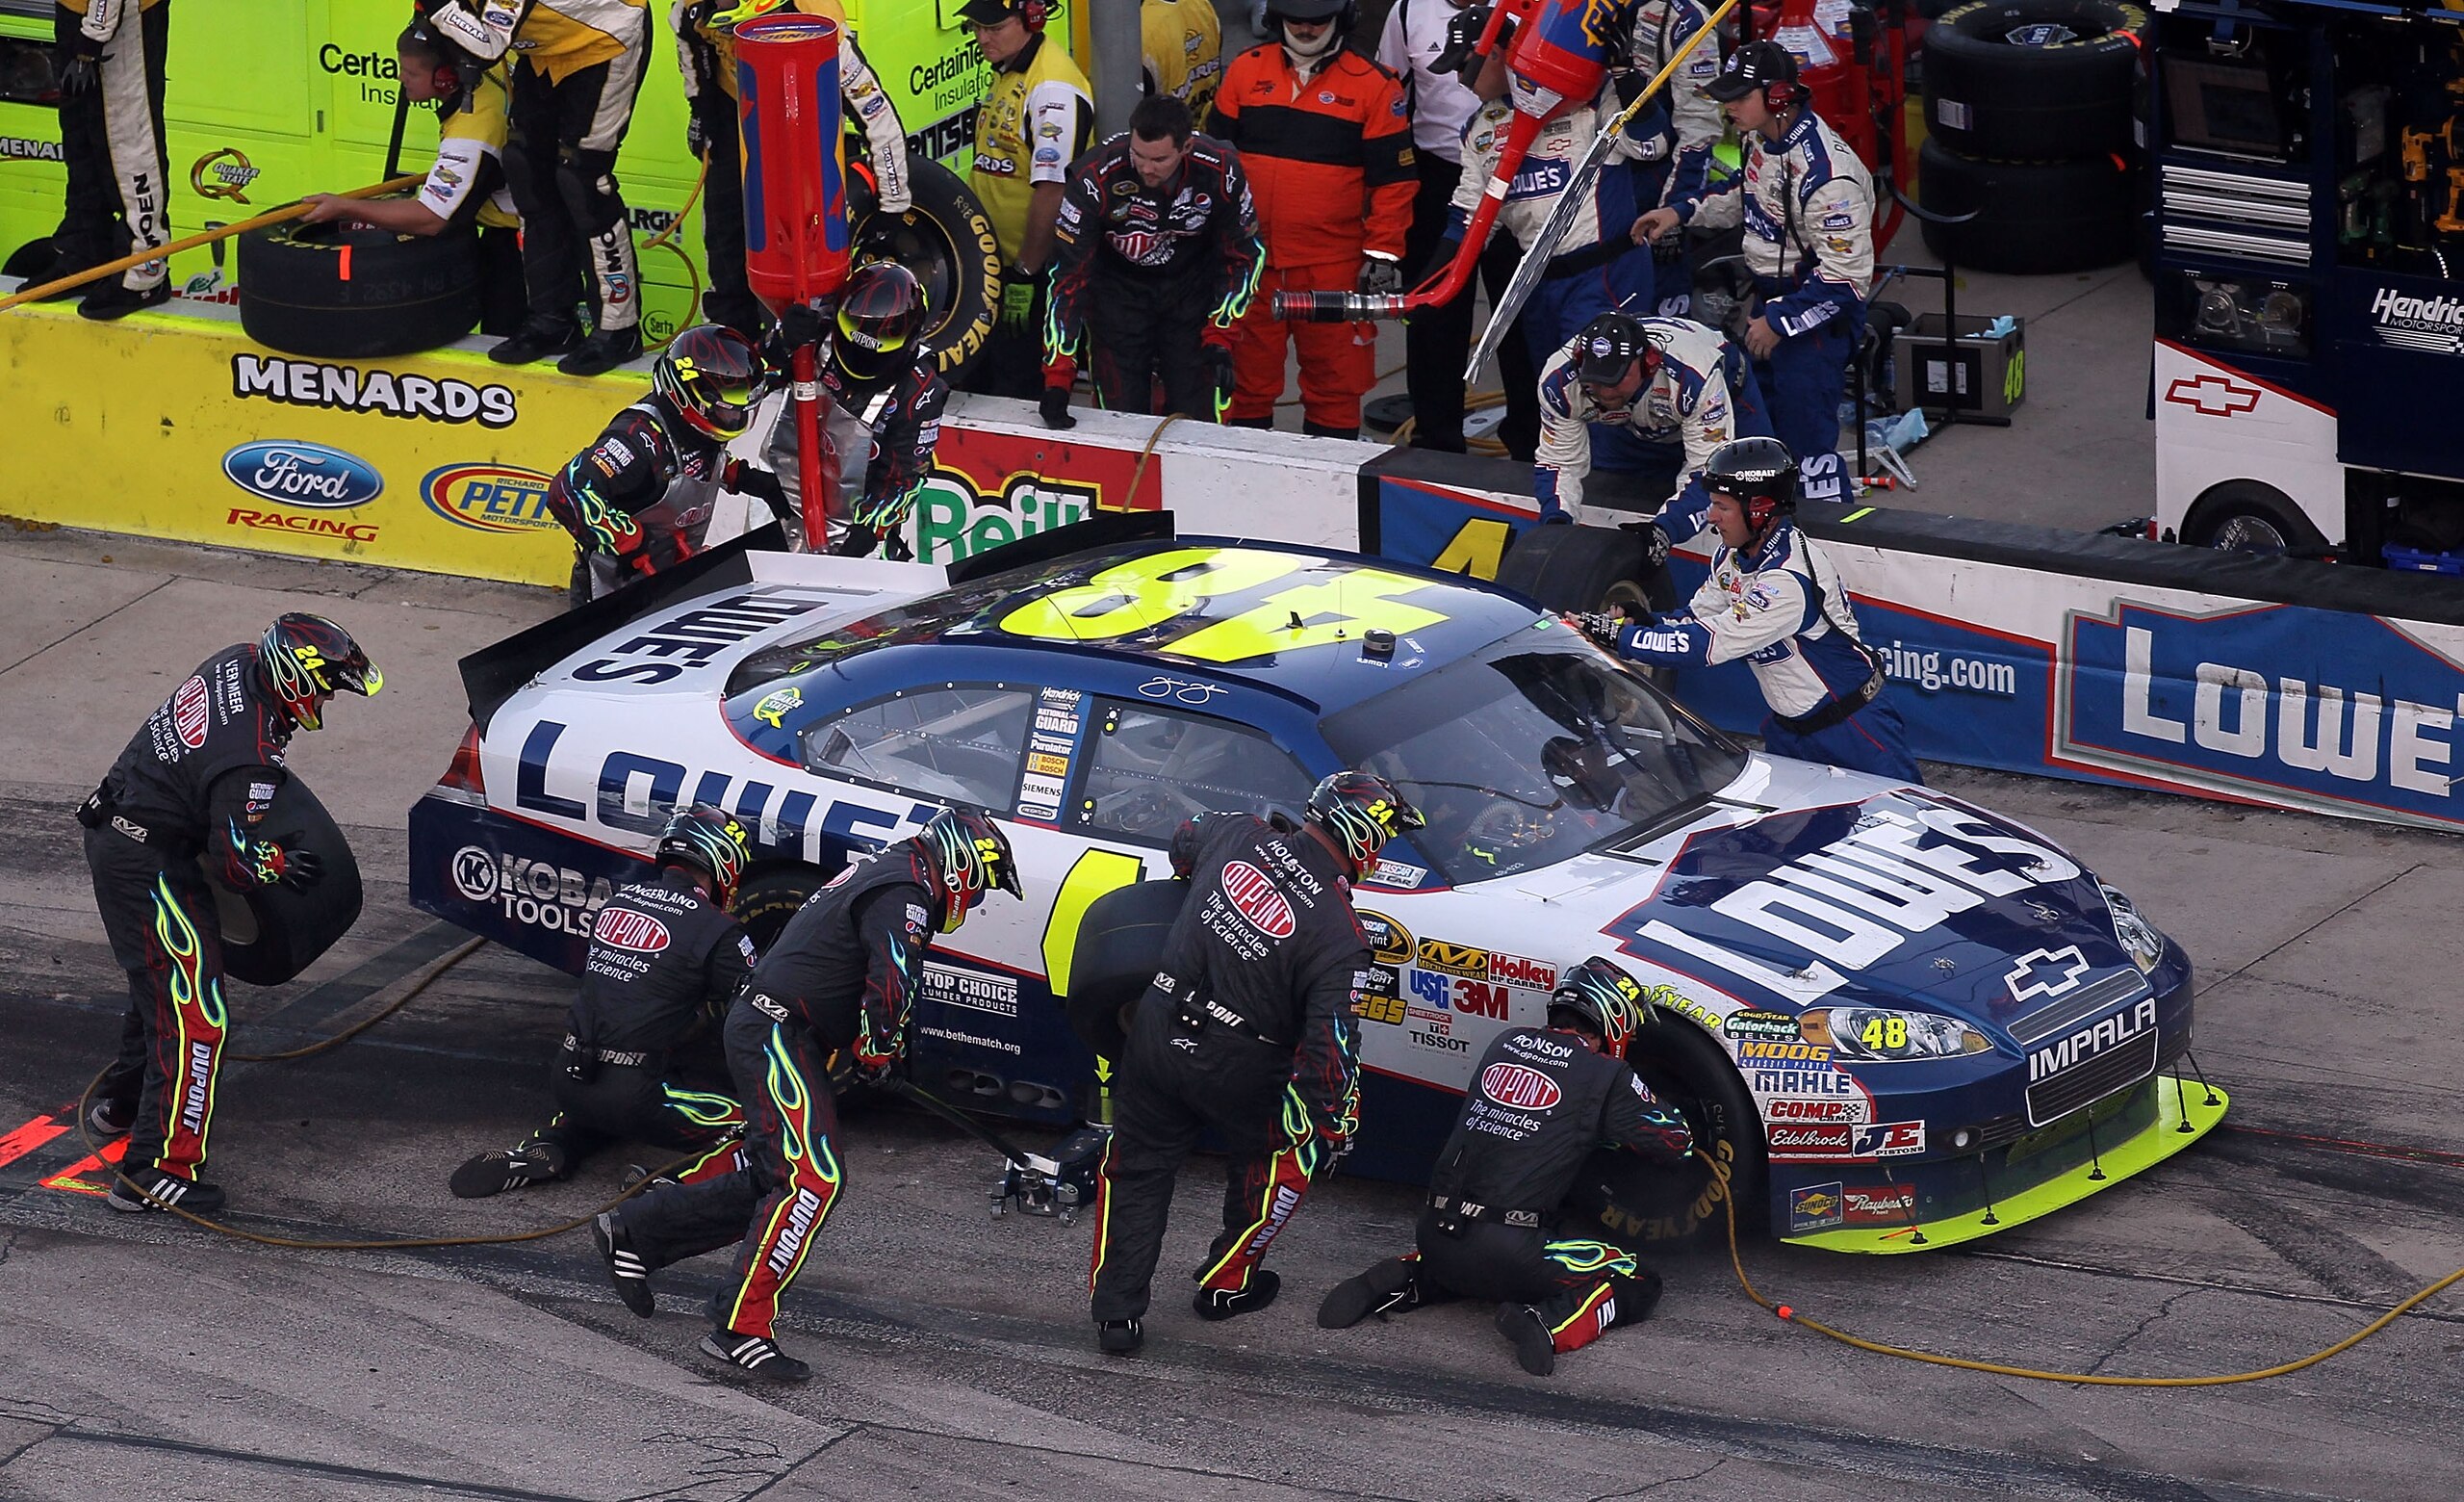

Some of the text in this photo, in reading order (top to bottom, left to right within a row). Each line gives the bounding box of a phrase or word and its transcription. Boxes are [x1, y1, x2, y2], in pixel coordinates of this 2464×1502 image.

[320, 43, 397, 79] Certa
[910, 41, 984, 96] CertainTe
[935, 68, 993, 111] Insulatio
[213, 163, 260, 177] QUAKER
[975, 155, 1015, 171] ARDS
[220, 174, 250, 186] STATE
[2371, 288, 2464, 325] Hendric
[650, 317, 673, 334] Serta
[2390, 317, 2464, 335] MOTORSPOR
[674, 356, 700, 382] 24
[2003, 350, 2024, 399] 48
[234, 355, 517, 428] MENARDS
[254, 450, 348, 500] Ford
[496, 478, 545, 489] RICHARD
[1745, 469, 1776, 478] KOBALT
[459, 480, 552, 516] PETT
[226, 508, 379, 543] RACING
[480, 513, 561, 531] MOTORSPORTS
[999, 547, 1451, 663] 48
[1630, 630, 1690, 652] LOWE'S
[294, 645, 326, 671] 24
[224, 659, 244, 714] VERMEER
[1040, 686, 1081, 702] Hendrick
[177, 677, 206, 744] DUPONT
[766, 701, 793, 713] STATE
[1038, 708, 1068, 719] NATIONAL
[1035, 715, 1078, 735] GUARD
[1031, 740, 1072, 755] Purolator
[1040, 764, 1064, 774] BOSCH
[1041, 757, 1065, 765] BOSCH
[1022, 783, 1061, 797] SIEMENS
[1367, 799, 1394, 824] 24
[724, 819, 748, 844] 24
[973, 837, 999, 864] 24
[1253, 843, 1315, 909] www.dupnt.com
[1267, 839, 1324, 895] HOUSTON
[1379, 863, 1414, 877] NASCAR
[500, 851, 613, 912] KOBA
[1224, 863, 1293, 936] DUPONT
[1636, 791, 2082, 1007] LOWE'S
[500, 892, 591, 938] TOOLS
[1204, 891, 1270, 958] The miracles
[595, 910, 665, 948] DUPONT
[1200, 908, 1253, 961] of science
[1368, 933, 1387, 946] rint
[599, 949, 651, 973] miracles
[1419, 960, 1487, 981] MECHANIX WEAR
[1491, 954, 1555, 991] Holley
[923, 971, 1017, 1004] TOP CHOICE
[1410, 970, 1450, 1009] USG
[1501, 976, 1545, 990] CARBS
[1616, 976, 1640, 1001] 24
[922, 987, 1017, 1014] LUMBER PRODUCTS
[1206, 1000, 1245, 1027] PONT
[1453, 979, 1508, 1022] 3M
[1408, 1008, 1451, 1021] SHEETROCK
[1726, 1018, 1799, 1035] Gatorback
[1736, 1011, 1790, 1021] GOODYEAR
[920, 1025, 1021, 1055] www.bethematch.org
[1409, 1031, 1471, 1053] TISSOT
[1731, 1032, 1793, 1041] BELTS
[1861, 1017, 1907, 1050] 48
[2030, 997, 2156, 1081] IMPALA
[1740, 1042, 1832, 1061] MOOG
[1742, 1059, 1828, 1071] CHASSIS PARTS
[183, 1041, 212, 1134] DUPONT
[1484, 1065, 1555, 1107] DUPONT
[1756, 1071, 1850, 1094] MAHLE
[1470, 1099, 1542, 1132] The miracles
[1771, 1101, 1842, 1119] COMP
[1465, 1116, 1524, 1142] of science
[1770, 1128, 1848, 1147] Edelbrock
[1855, 1122, 1920, 1154] JE
[1876, 1147, 1924, 1155] PISTONS
[1796, 1196, 1837, 1212] SUNOCO
[767, 1186, 820, 1281] DUPONT
